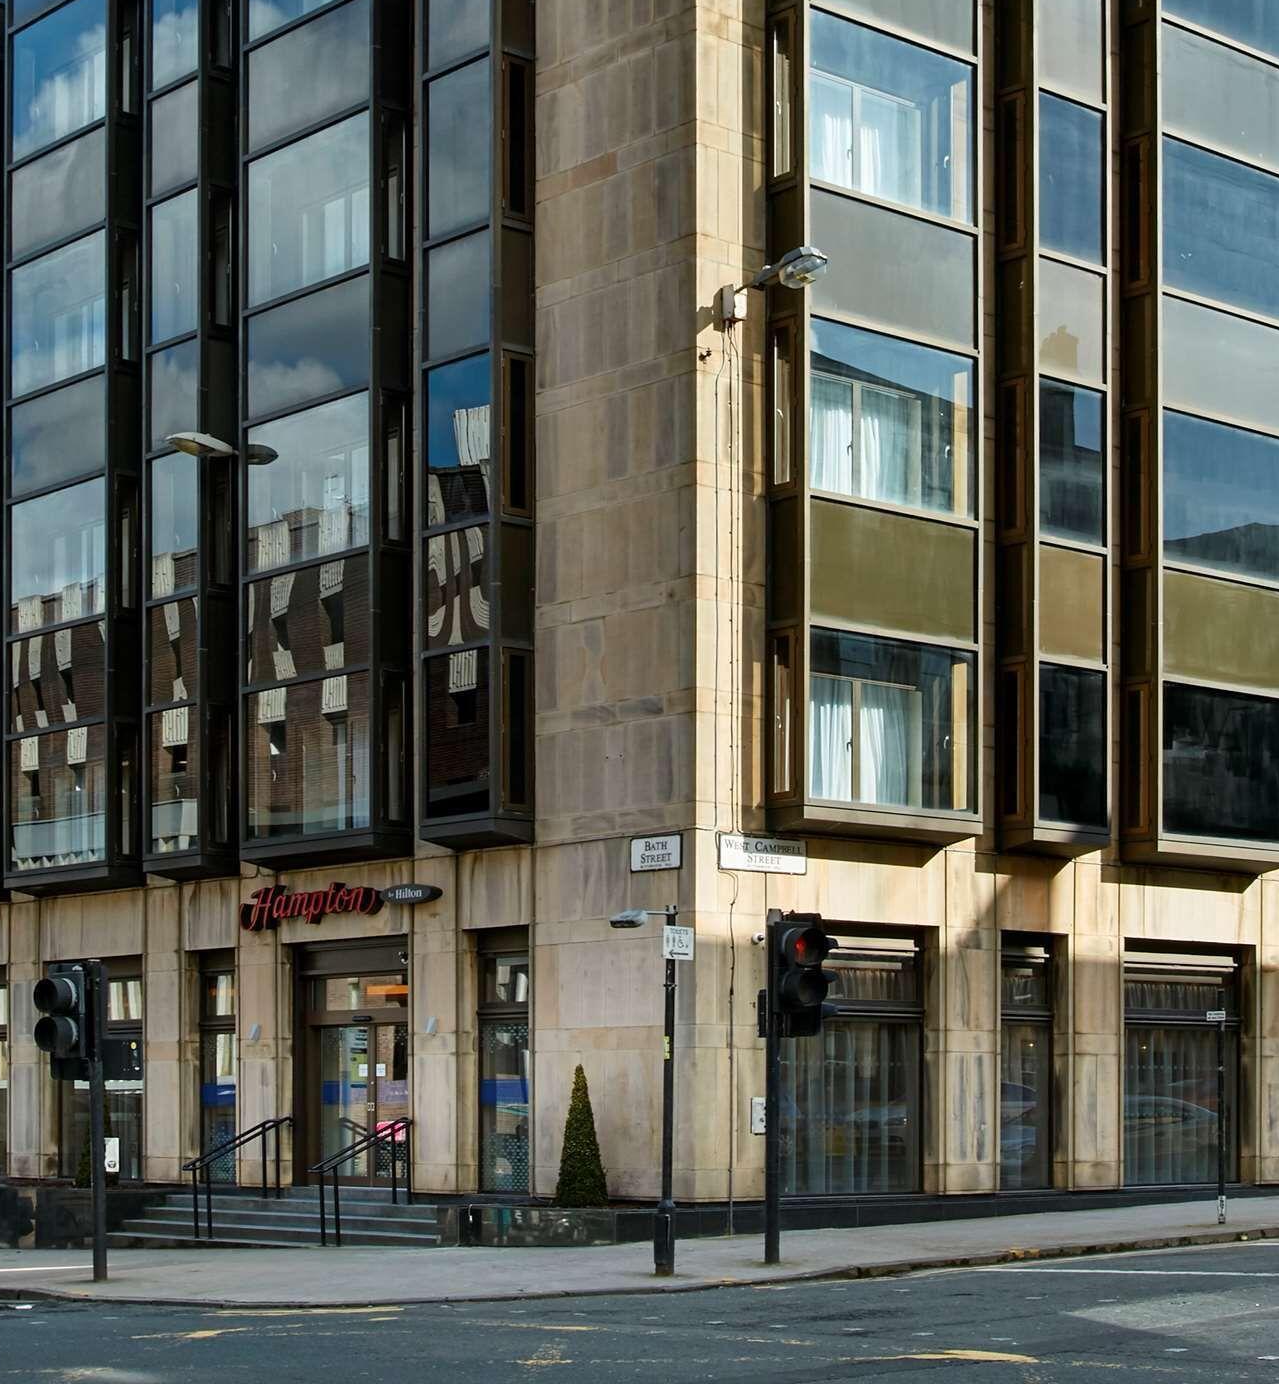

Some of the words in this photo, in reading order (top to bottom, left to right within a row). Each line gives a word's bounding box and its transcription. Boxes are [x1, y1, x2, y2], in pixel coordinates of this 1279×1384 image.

[644, 841, 668, 852] BATH
[724, 839, 750, 851] WEST
[754, 841, 801, 855] CAMPBELL
[640, 852, 672, 864] STREET
[747, 855, 782, 865] STREET
[239, 882, 376, 931] Hampton
[395, 889, 423, 900] Hilton
